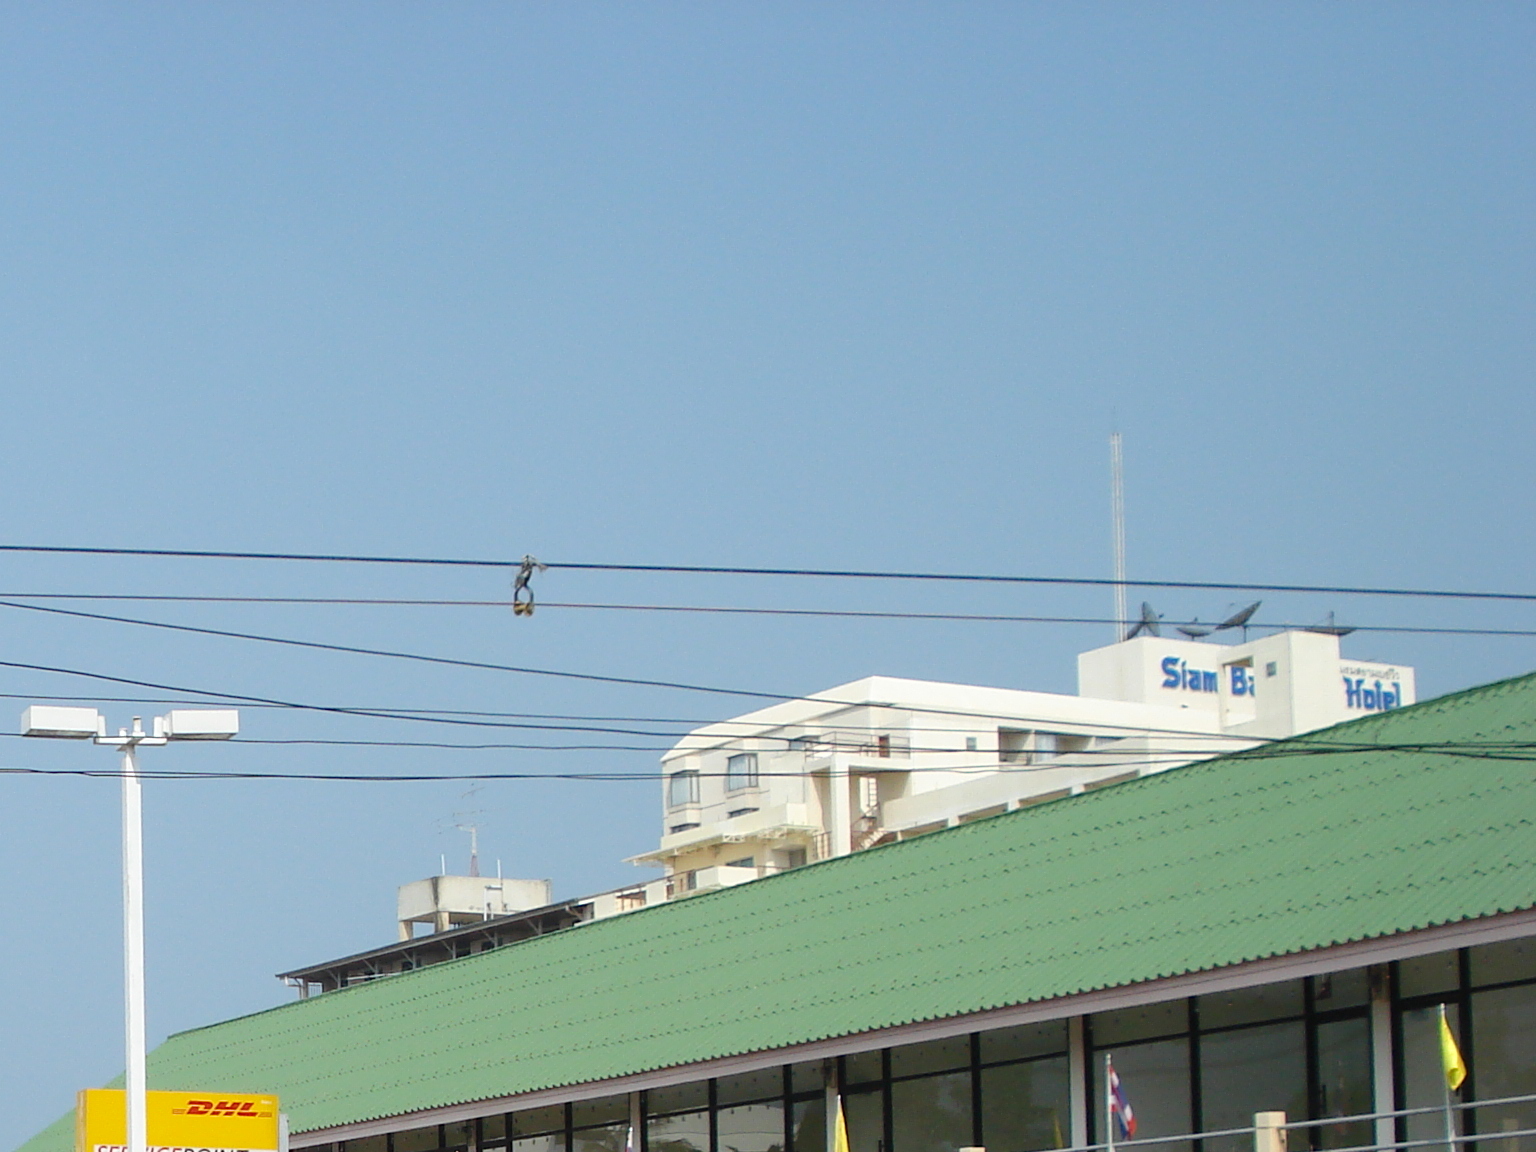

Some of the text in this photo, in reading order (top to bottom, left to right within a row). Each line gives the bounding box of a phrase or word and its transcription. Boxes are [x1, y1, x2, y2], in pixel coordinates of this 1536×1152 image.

[1161, 656, 1219, 693] Siam
[1342, 676, 1402, 712] Hotel
[186, 1100, 259, 1117] DHL
